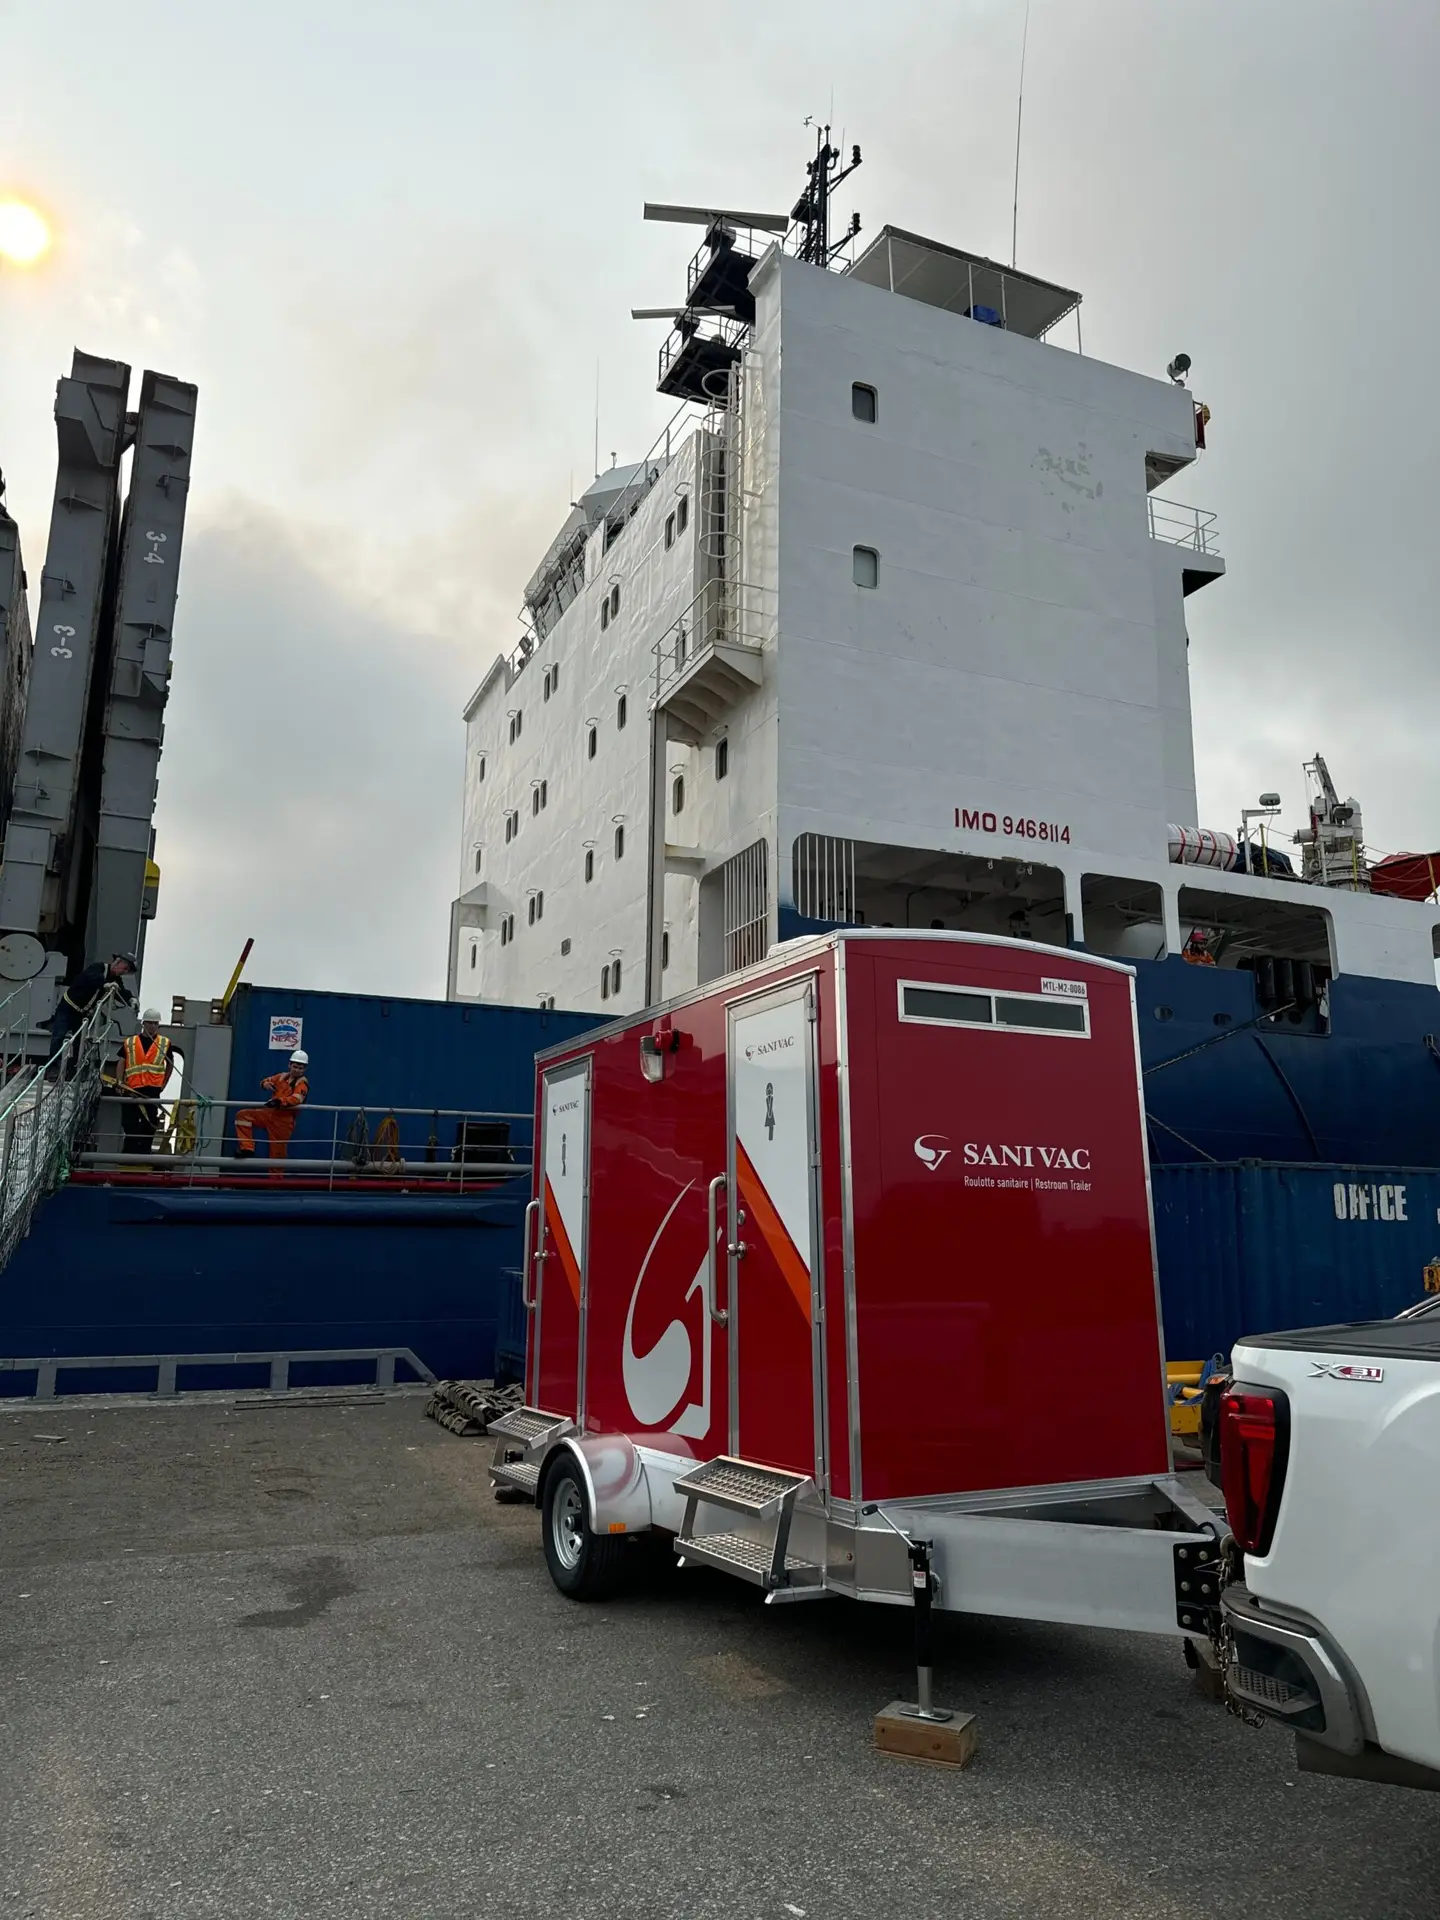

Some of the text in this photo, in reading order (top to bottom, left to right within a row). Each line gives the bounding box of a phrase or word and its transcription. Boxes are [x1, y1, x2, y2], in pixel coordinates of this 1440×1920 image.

[144, 531, 167, 564] 3-4
[50, 624, 76, 659] 3-3
[954, 808, 1071, 844] IMO 9468114
[757, 1036, 795, 1056] SANIVAC
[963, 1143, 1091, 1170] SANIVAC
[964, 1176, 1092, 1191] Roulotte sanitaire Restroom Trailer
[1333, 1183, 1408, 1221] OFFICE
